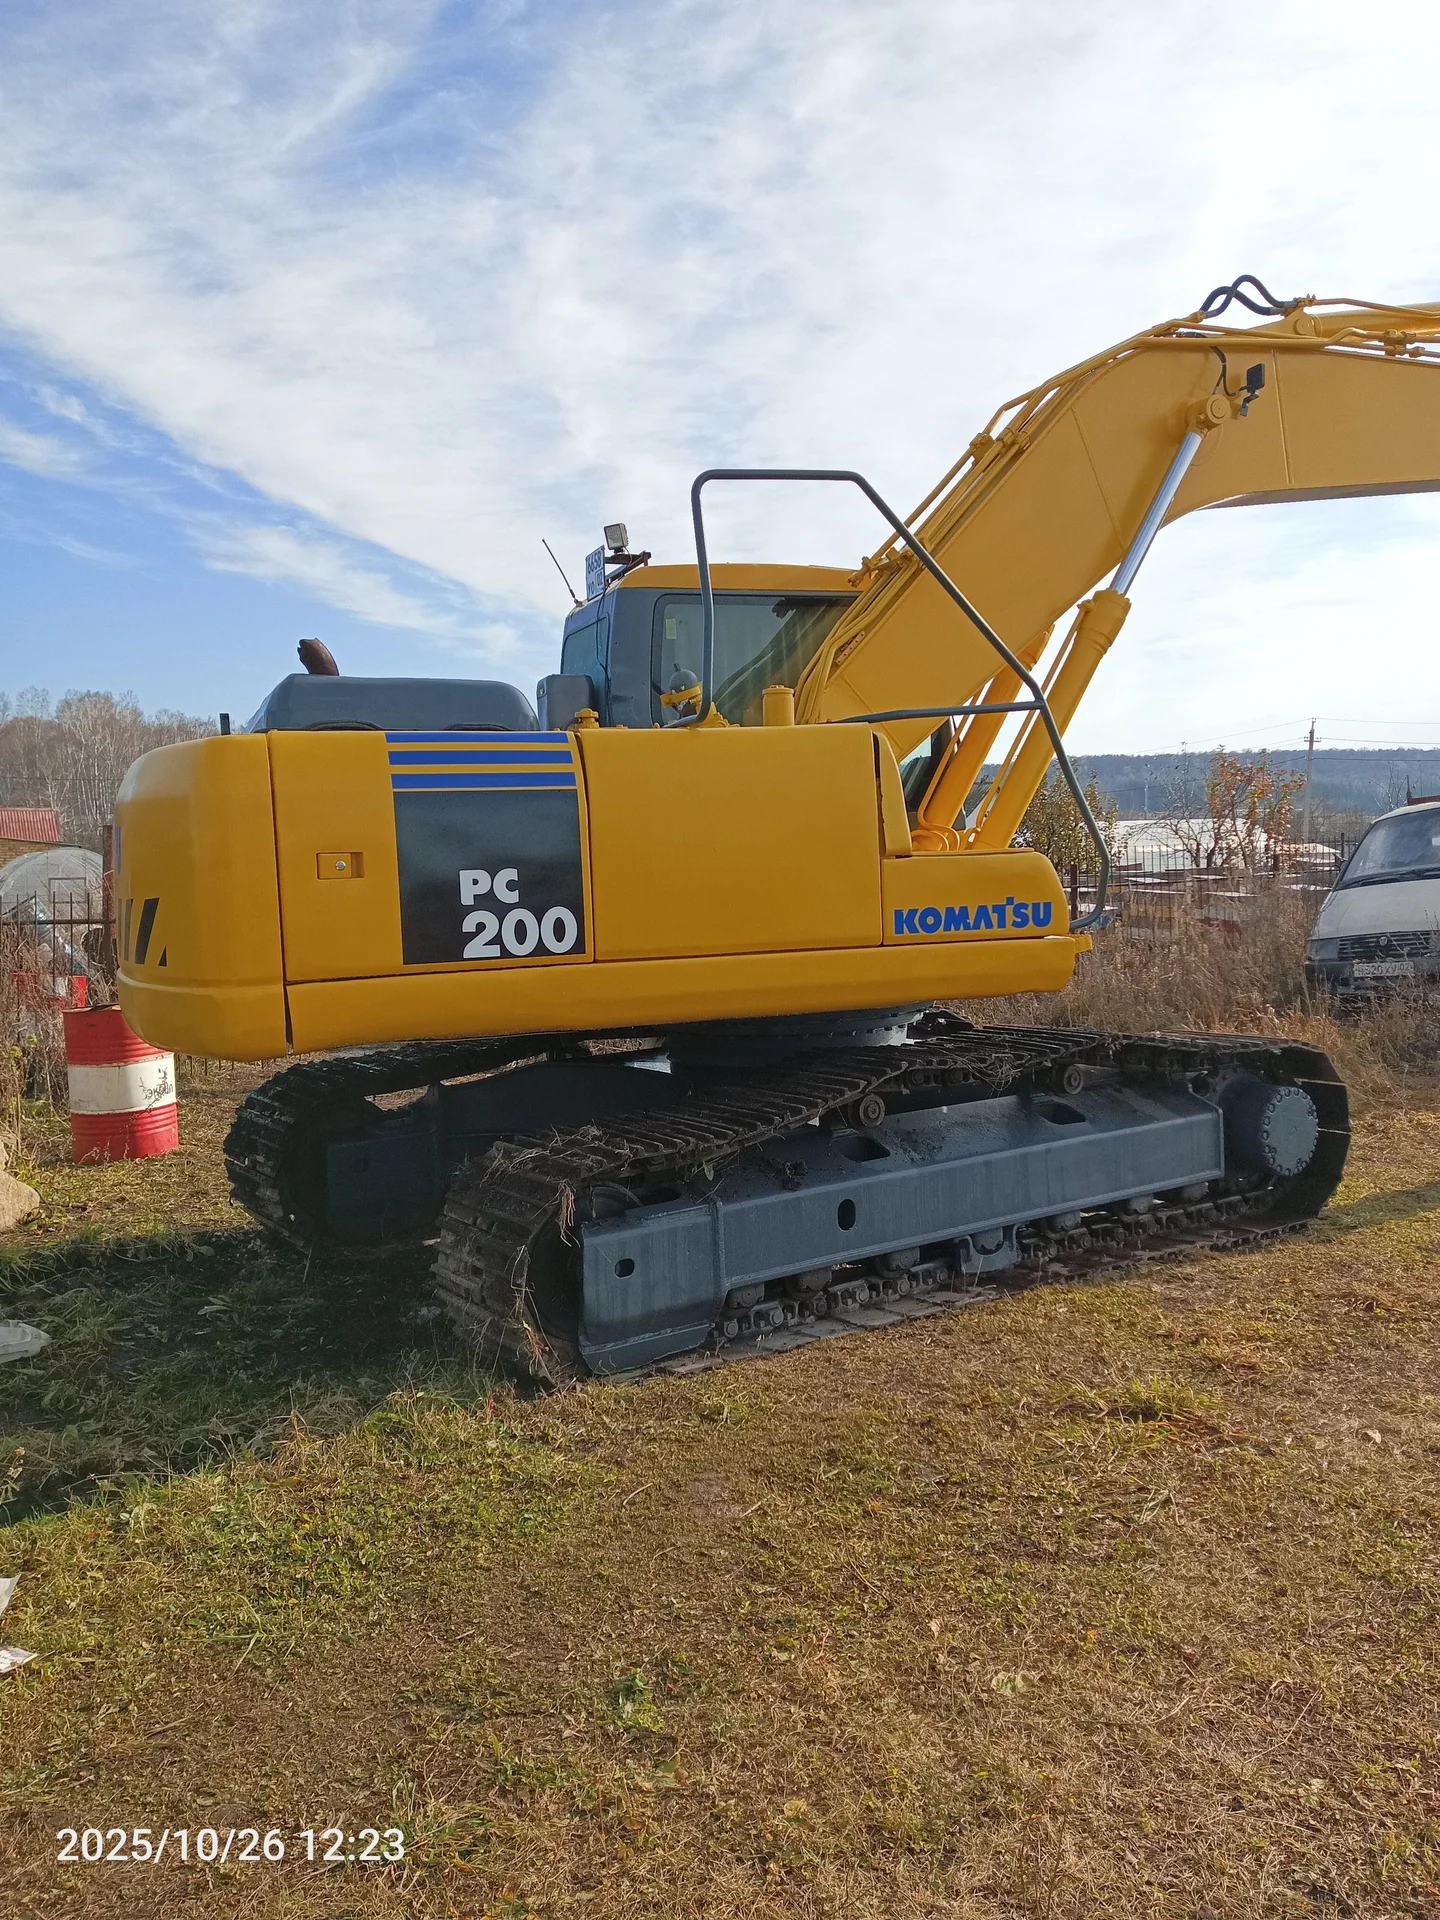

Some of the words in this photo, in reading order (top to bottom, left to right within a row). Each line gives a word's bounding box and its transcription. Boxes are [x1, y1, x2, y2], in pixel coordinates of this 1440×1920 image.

[459, 867, 519, 905] PC
[462, 906, 578, 958] 200
[894, 896, 1052, 935] KOMATSU
